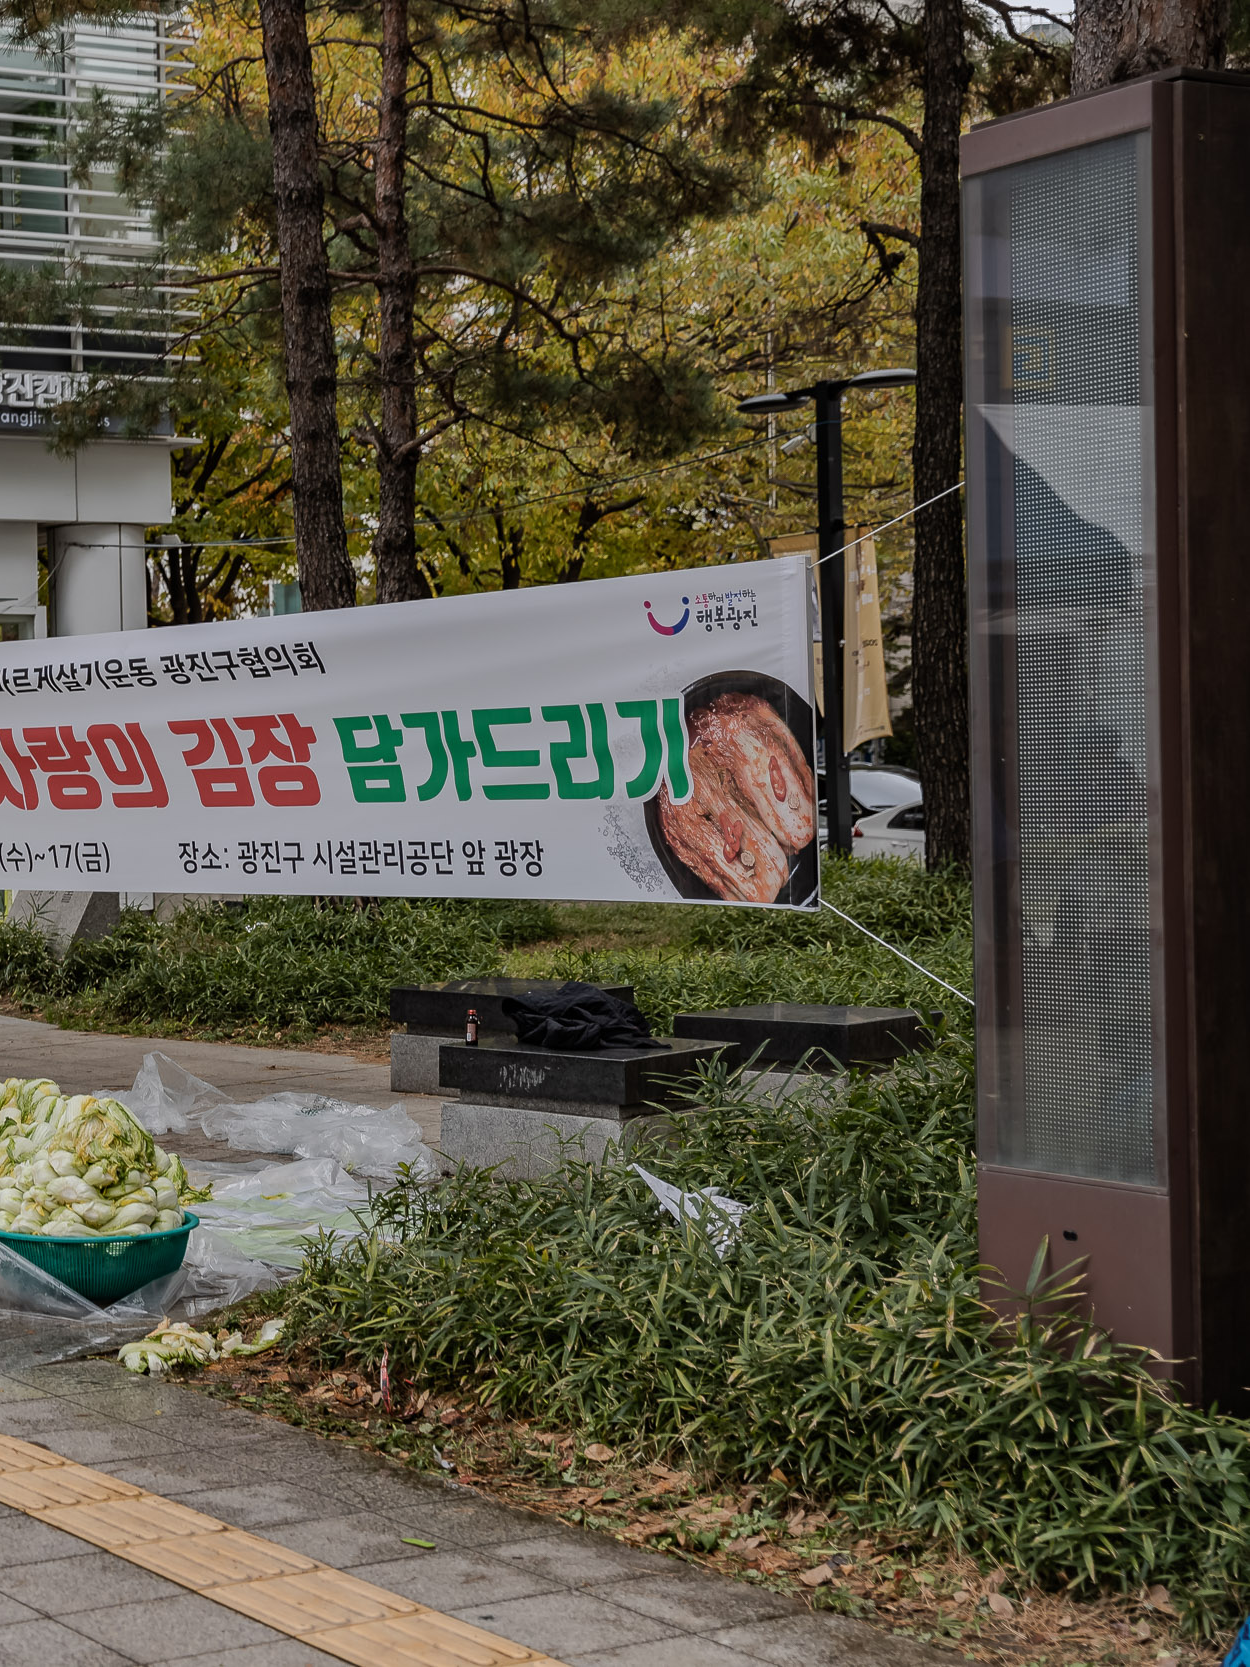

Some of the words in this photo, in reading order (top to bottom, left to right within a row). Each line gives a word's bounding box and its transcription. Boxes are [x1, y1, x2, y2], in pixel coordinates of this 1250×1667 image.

[695, 592, 724, 608] 소통하며
[725, 589, 757, 606] 발전하는
[696, 604, 758, 632] 행복광진
[159, 641, 326, 685] 광진구협의회
[167, 713, 321, 807] 김장
[332, 698, 690, 803] 담가드리기
[178, 841, 229, 874] 장소:
[237, 841, 305, 874] 광진구
[312, 840, 454, 876] 시설관리공단
[462, 840, 486, 876] 앞
[494, 840, 544, 877] 광장
